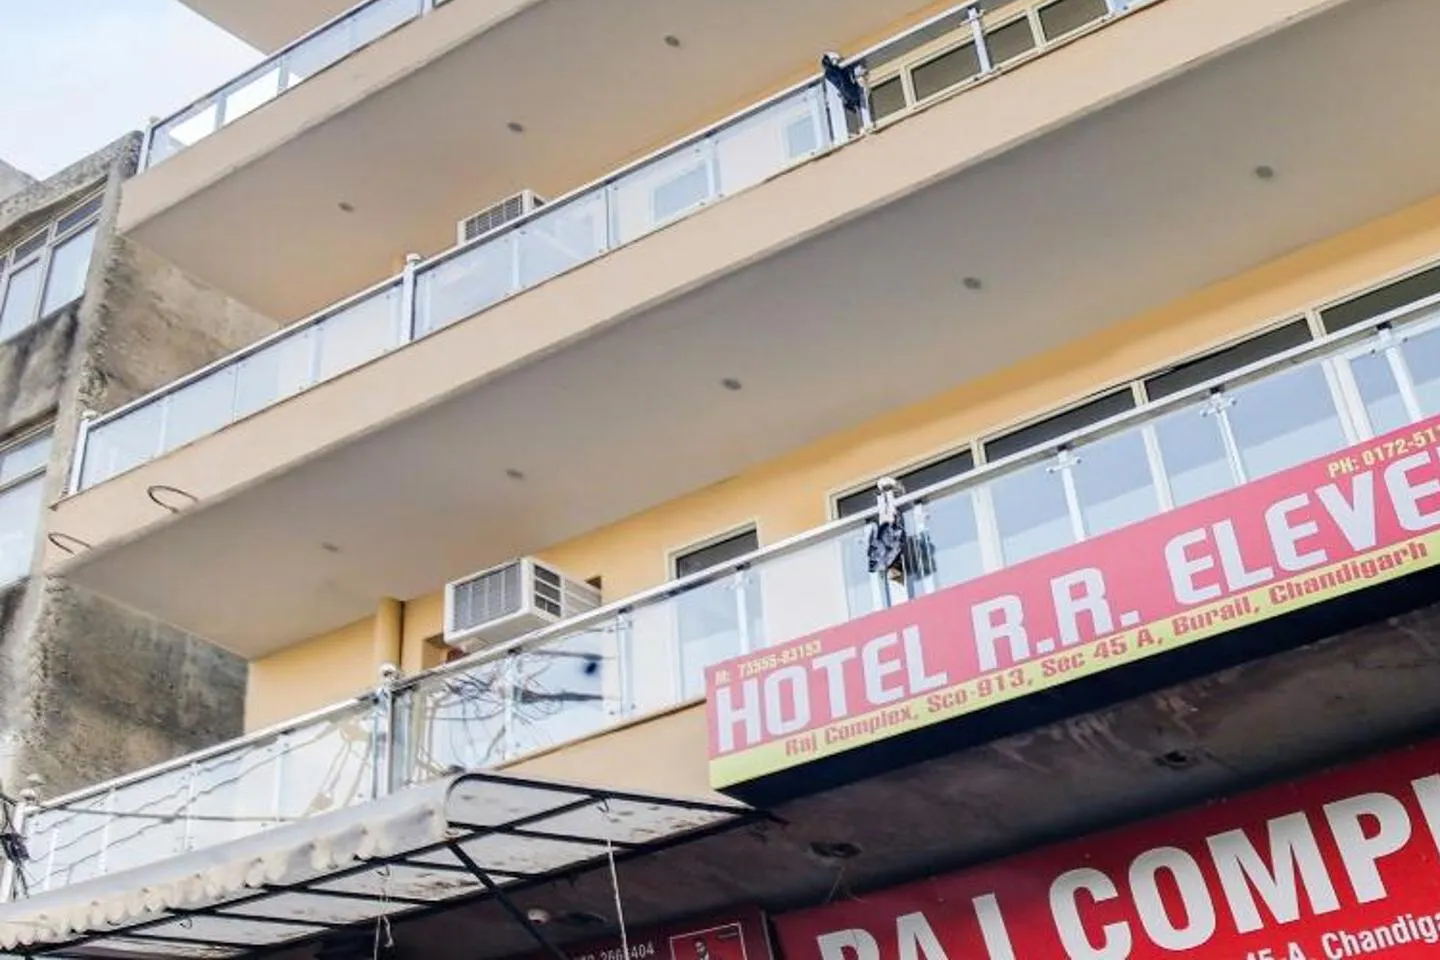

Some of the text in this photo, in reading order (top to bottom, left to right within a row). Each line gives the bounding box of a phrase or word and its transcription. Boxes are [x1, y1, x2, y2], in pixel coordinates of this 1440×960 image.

[1327, 458, 1360, 479] PH:
[715, 624, 948, 753] HOTEL
[785, 736, 818, 757] Raj
[824, 704, 920, 745] Complex,
[1041, 652, 1085, 679] Sec
[1093, 636, 1128, 659] 45
[1269, 540, 1428, 605] Chandigarh
